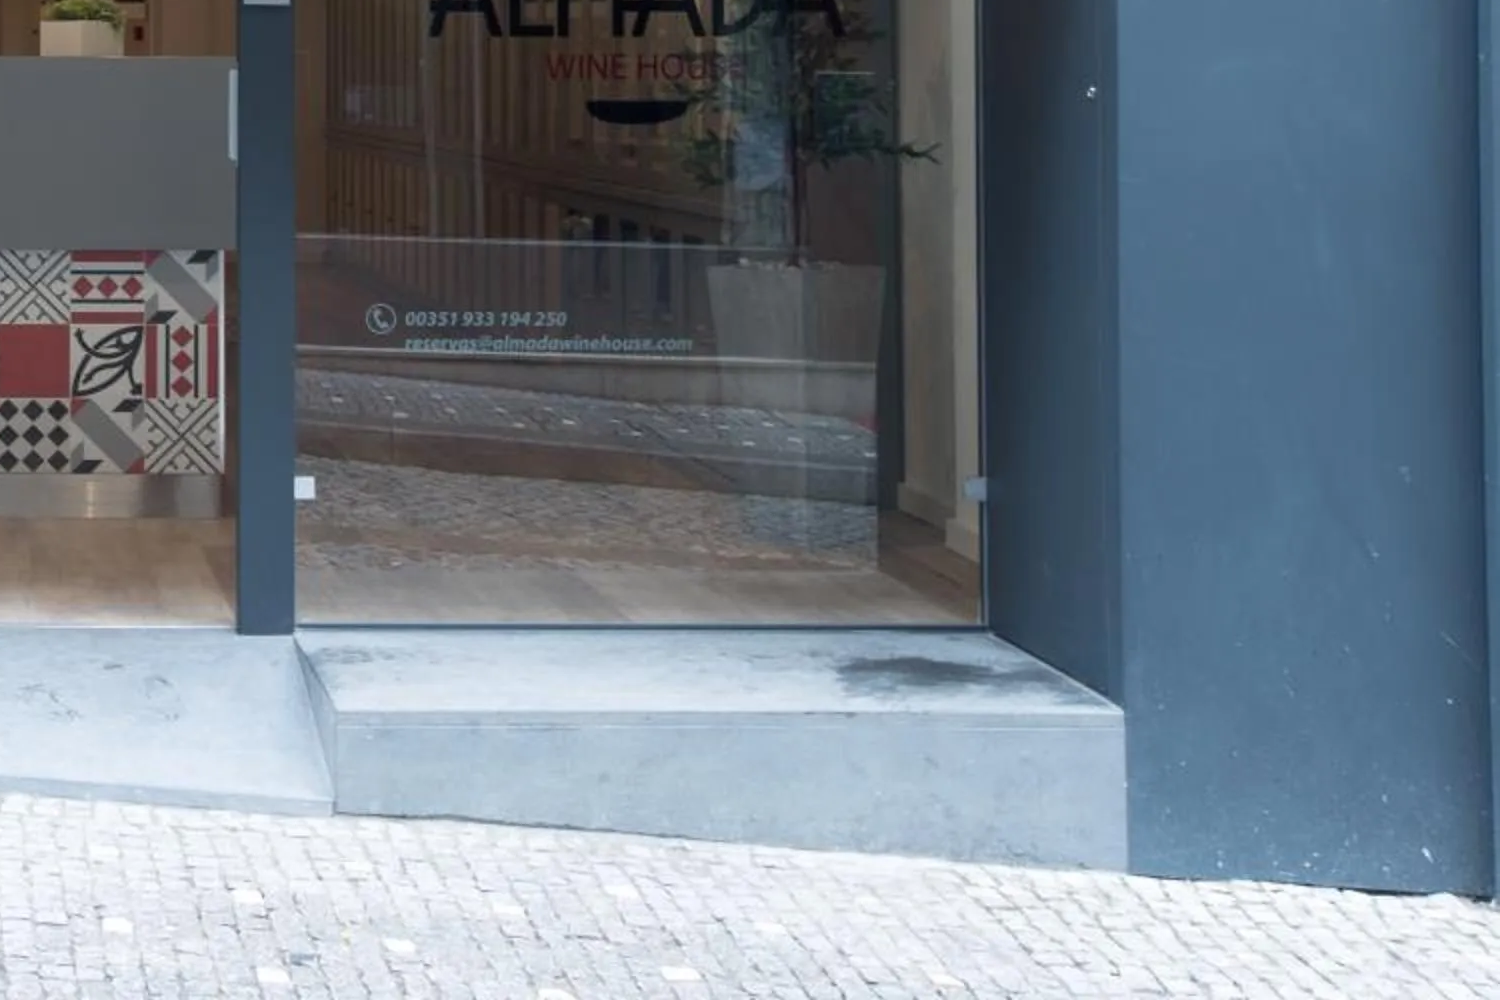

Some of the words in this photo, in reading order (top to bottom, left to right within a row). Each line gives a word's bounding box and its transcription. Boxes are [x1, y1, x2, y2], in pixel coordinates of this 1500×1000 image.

[546, 53, 626, 80] WINE
[405, 311, 456, 327] 00351
[463, 311, 495, 327] 933
[500, 311, 531, 327] 194
[535, 311, 568, 327] 250
